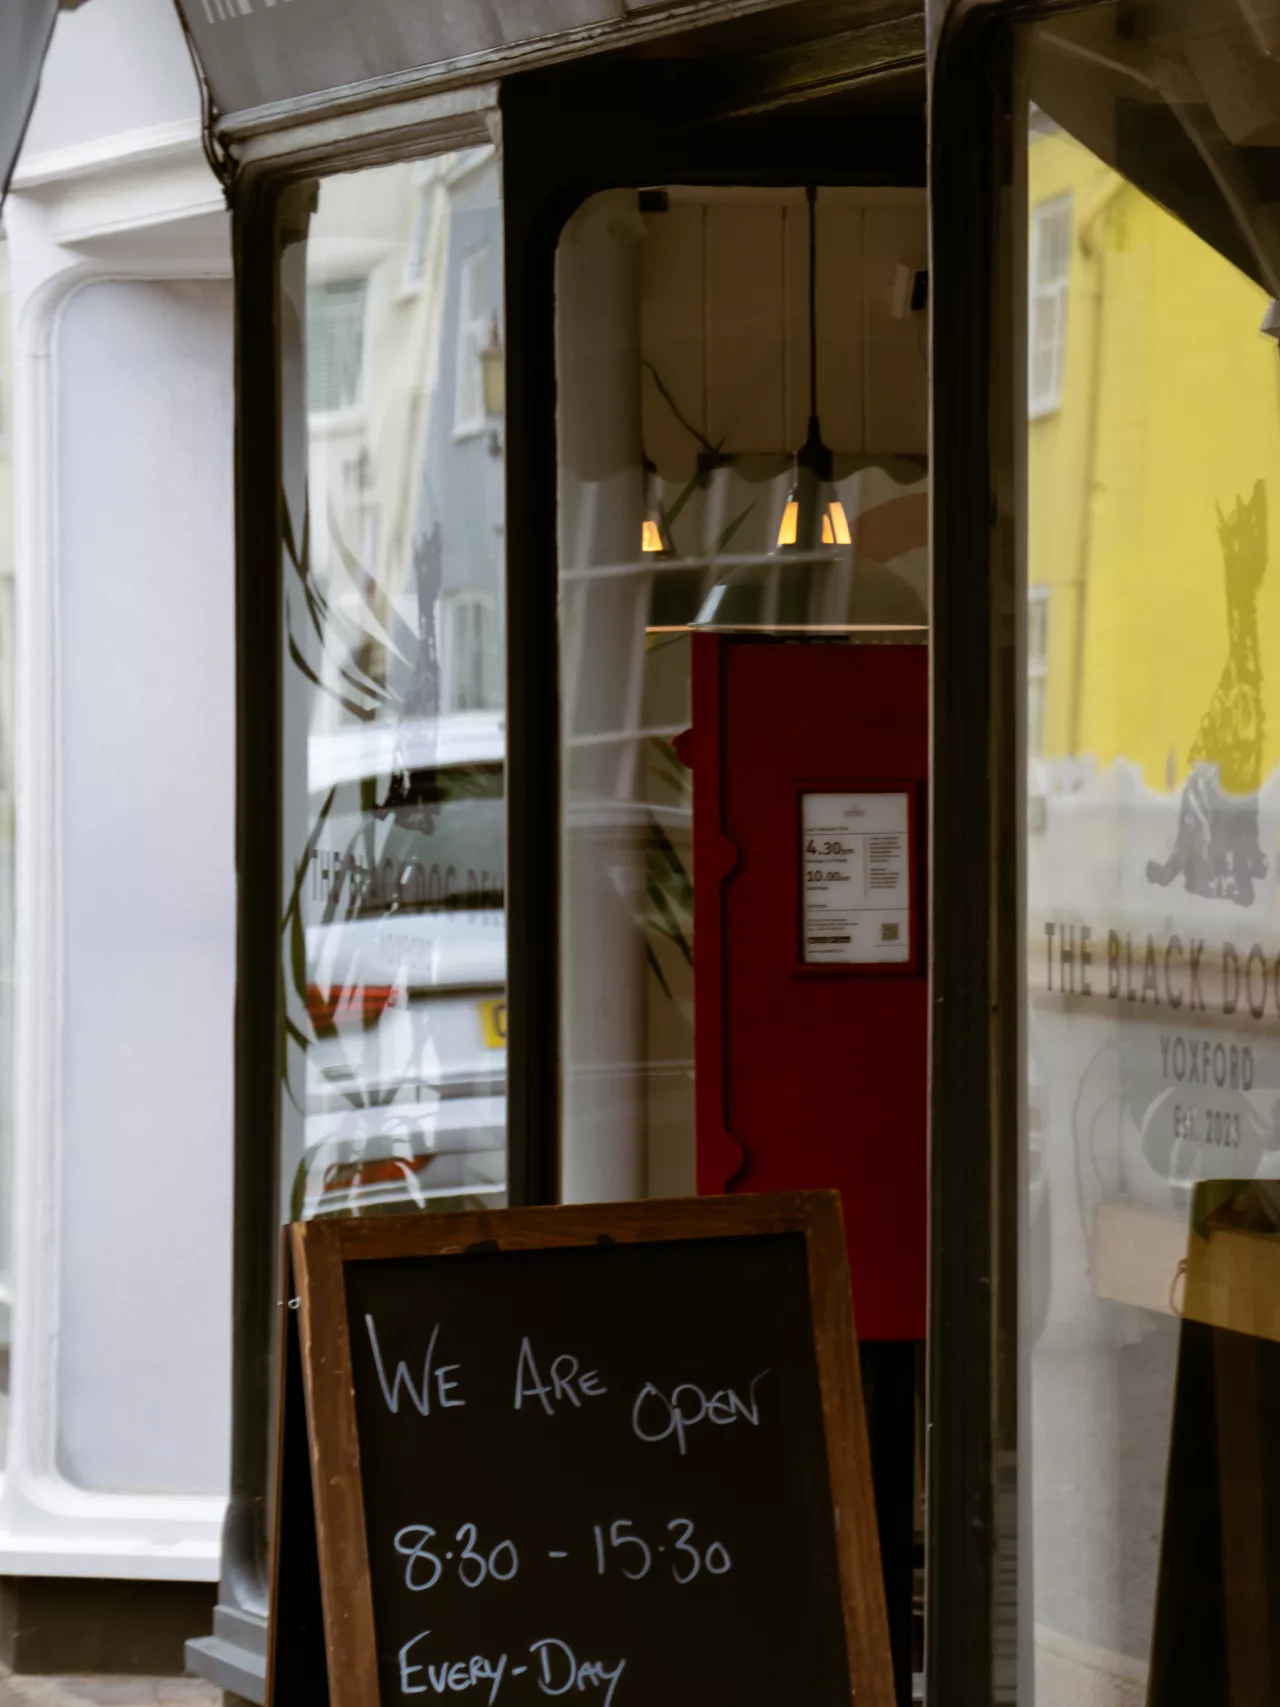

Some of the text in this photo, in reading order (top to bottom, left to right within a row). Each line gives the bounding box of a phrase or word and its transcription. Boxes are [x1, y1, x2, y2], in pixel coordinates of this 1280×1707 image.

[1045, 922, 1092, 997] THE
[1108, 928, 1206, 1012] BLACK
[1159, 1035, 1255, 1092] YOXFORD
[1205, 1108, 1242, 1150] 2023
